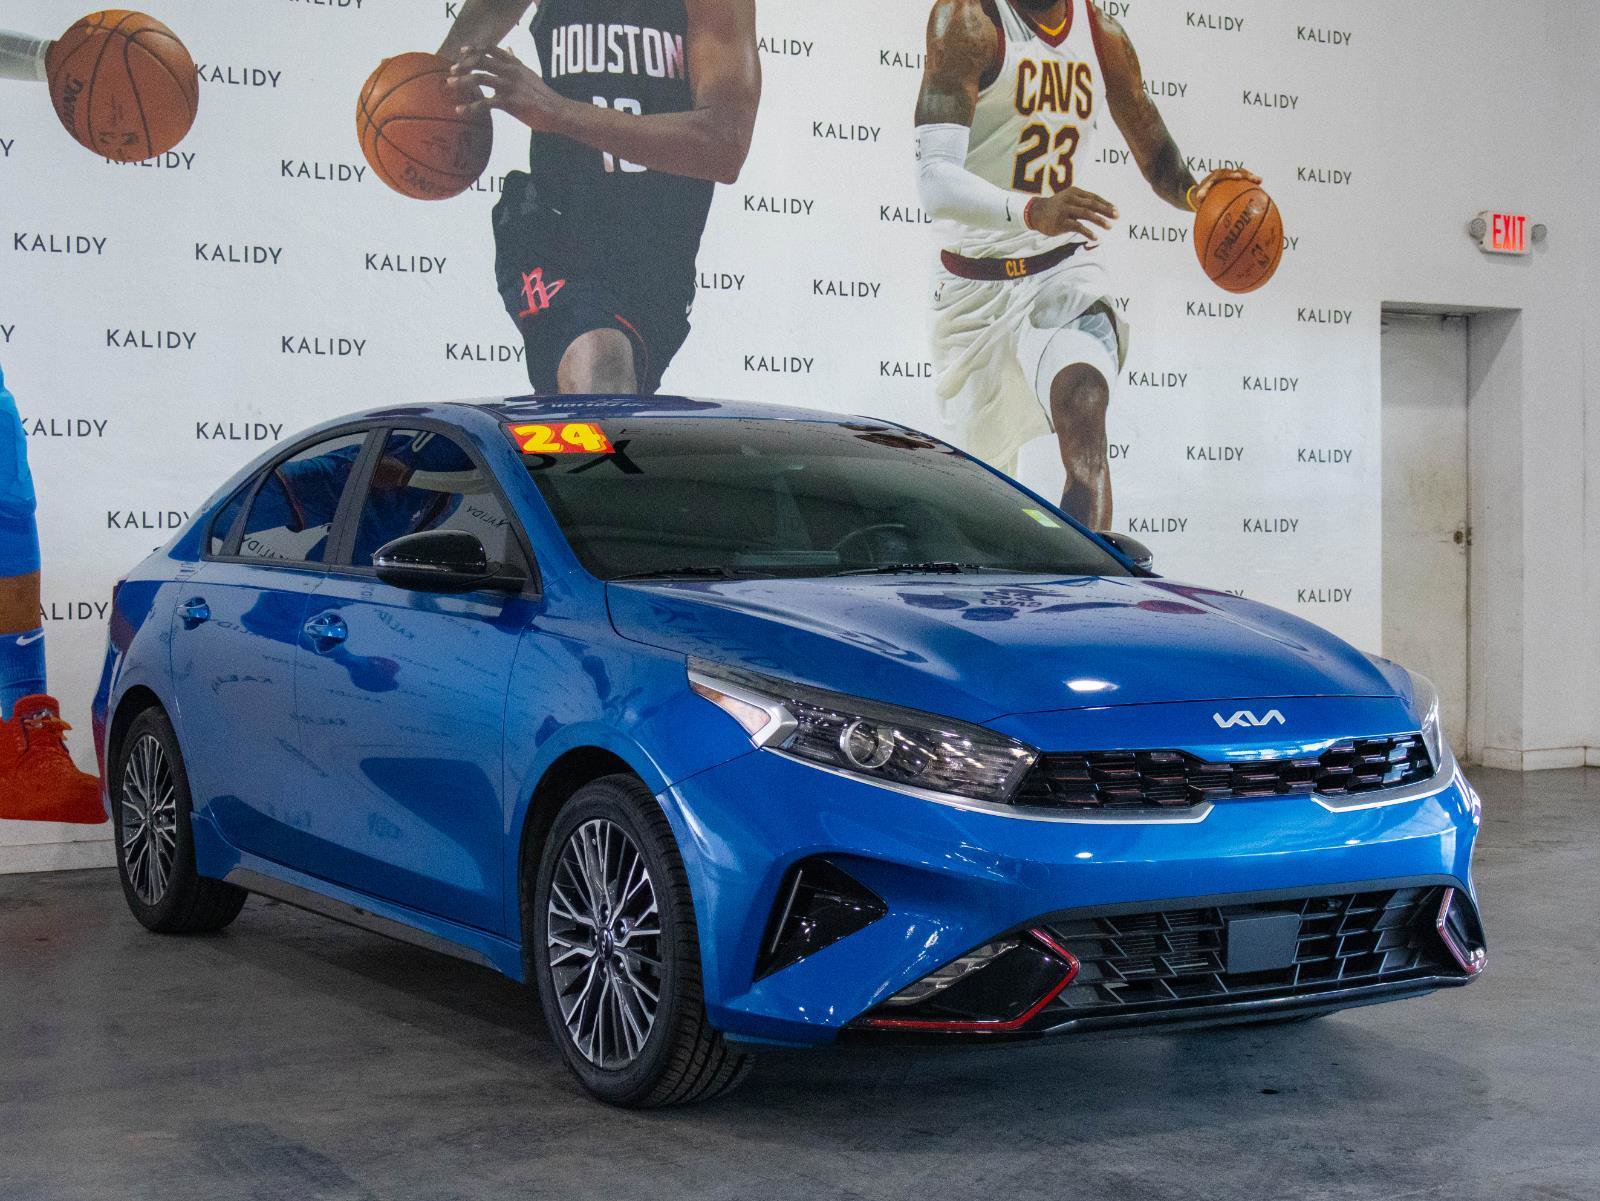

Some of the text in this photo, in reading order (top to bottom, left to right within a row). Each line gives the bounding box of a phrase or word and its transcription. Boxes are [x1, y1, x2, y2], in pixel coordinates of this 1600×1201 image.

[1186, 11, 1245, 33] KALIDY
[1297, 26, 1352, 46] KALIDY
[551, 23, 685, 80] HOUSTON
[757, 37, 814, 57] ALIDY
[880, 49, 927, 69] KALI
[195, 64, 282, 88] KALIDY
[1014, 57, 1093, 120] CAVS
[1142, 80, 1187, 97] ALIDY
[1242, 90, 1299, 110] KALIDY
[812, 120, 881, 143] KALIDY
[1011, 121, 1080, 194] 23
[281, 159, 367, 184] KALIDY
[1297, 167, 1352, 185] KALIDY
[743, 194, 815, 216] KALIDY
[880, 205, 933, 223] KALID
[1128, 224, 1188, 243] KALIDY
[1492, 213, 1526, 251] EXIT
[13, 232, 108, 255] KALIDY
[195, 242, 283, 265] KALIDY
[365, 252, 447, 275] KALIDY
[1005, 259, 1027, 277] CLE
[694, 272, 745, 291] LIDY
[813, 278, 881, 299] KALIDY
[1186, 300, 1244, 319] KALIDY
[1297, 307, 1353, 325] KALIDY
[106, 328, 197, 350] KALIDY
[281, 335, 367, 357] KALIDY
[445, 338, 525, 362] KALIDY
[744, 354, 814, 374] KALIDY
[880, 360, 932, 378] KALID
[1128, 370, 1188, 388] KALIDY
[1242, 375, 1299, 392] KALIDY
[195, 421, 283, 442] KALIDY
[513, 423, 608, 453] 24
[1186, 445, 1244, 462] KALIDY
[1297, 448, 1353, 464] KALIDY
[107, 510, 190, 529] KALID
[1128, 517, 1188, 533] KALIDY
[1243, 518, 1299, 533] KALIDY
[1297, 588, 1352, 603] KALIDY
[1212, 709, 1286, 729] KIA
